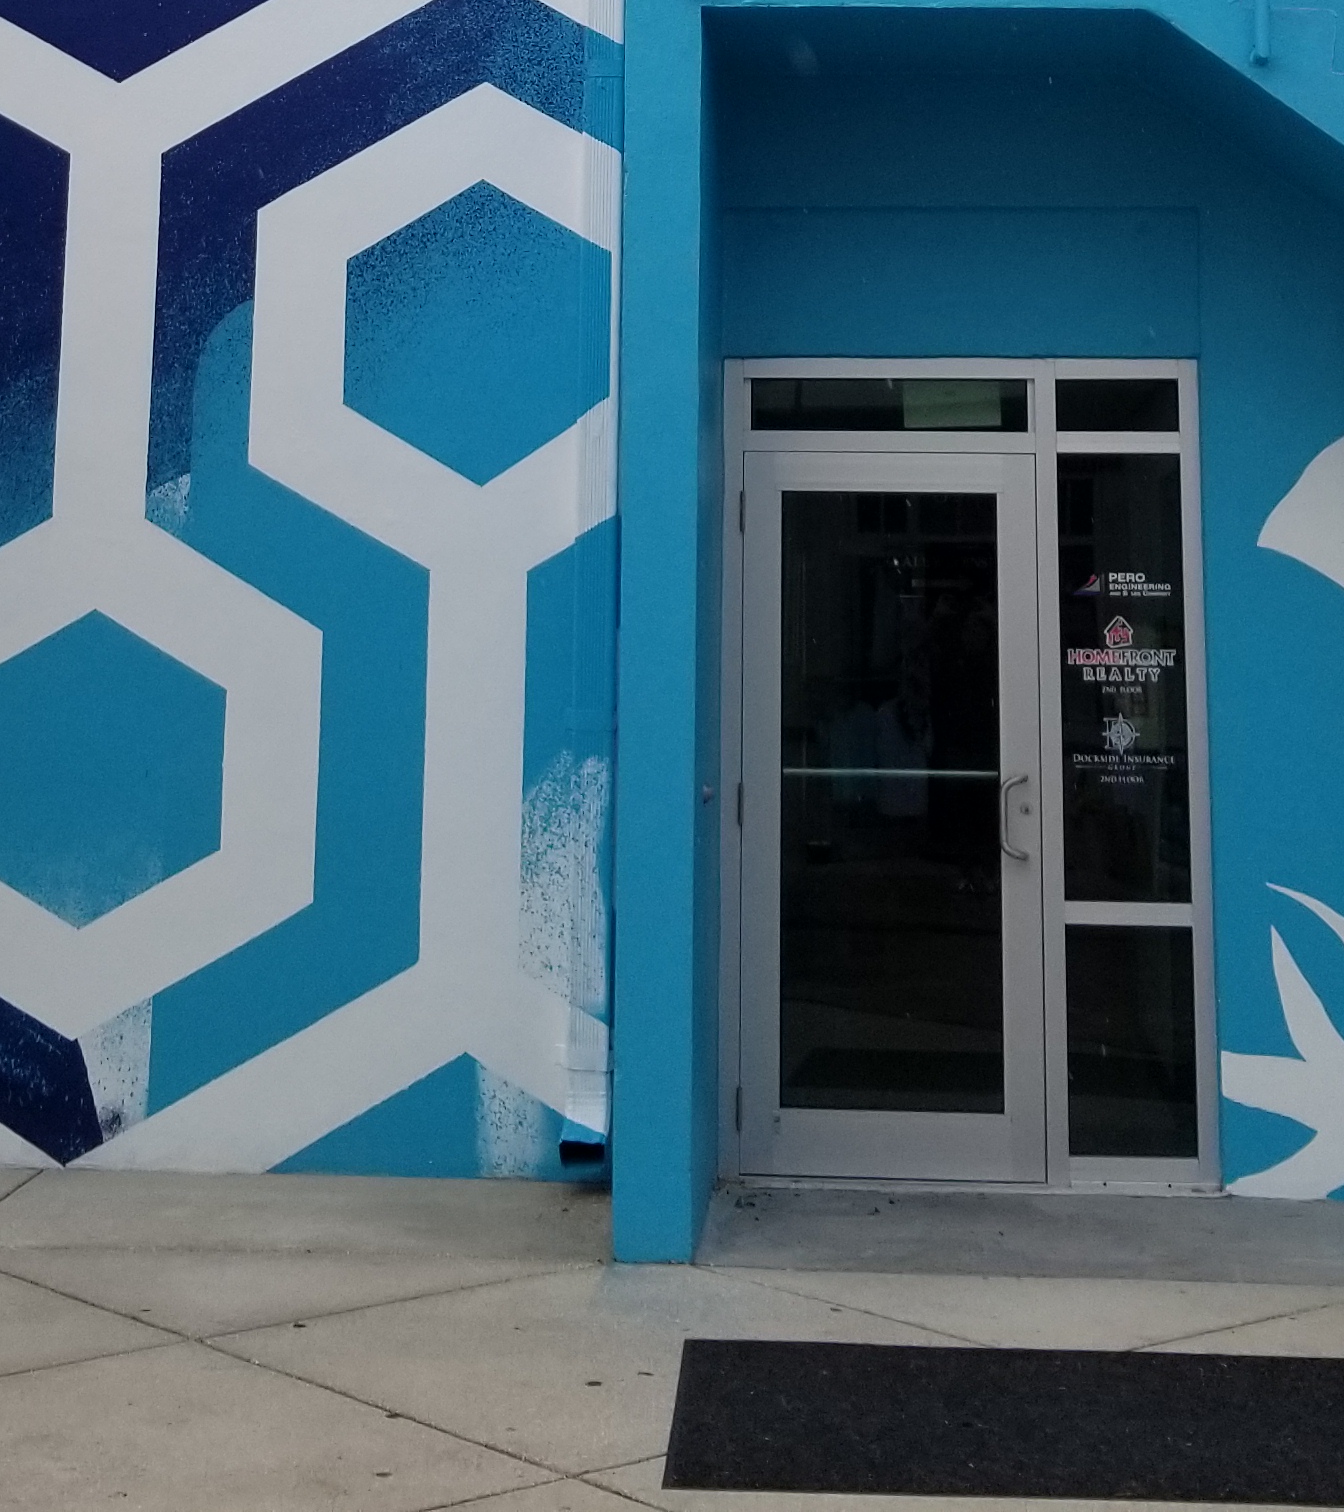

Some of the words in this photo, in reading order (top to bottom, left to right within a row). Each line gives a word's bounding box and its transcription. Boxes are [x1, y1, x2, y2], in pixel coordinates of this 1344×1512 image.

[1108, 572, 1146, 583] PERO
[1109, 583, 1171, 591] ENGINEERING
[1067, 648, 1177, 666] HOMEFRONT
[1082, 666, 1161, 682] REALTY
[1073, 753, 1120, 763] DOCKSIDE
[1123, 754, 1176, 765] INSURANCE
